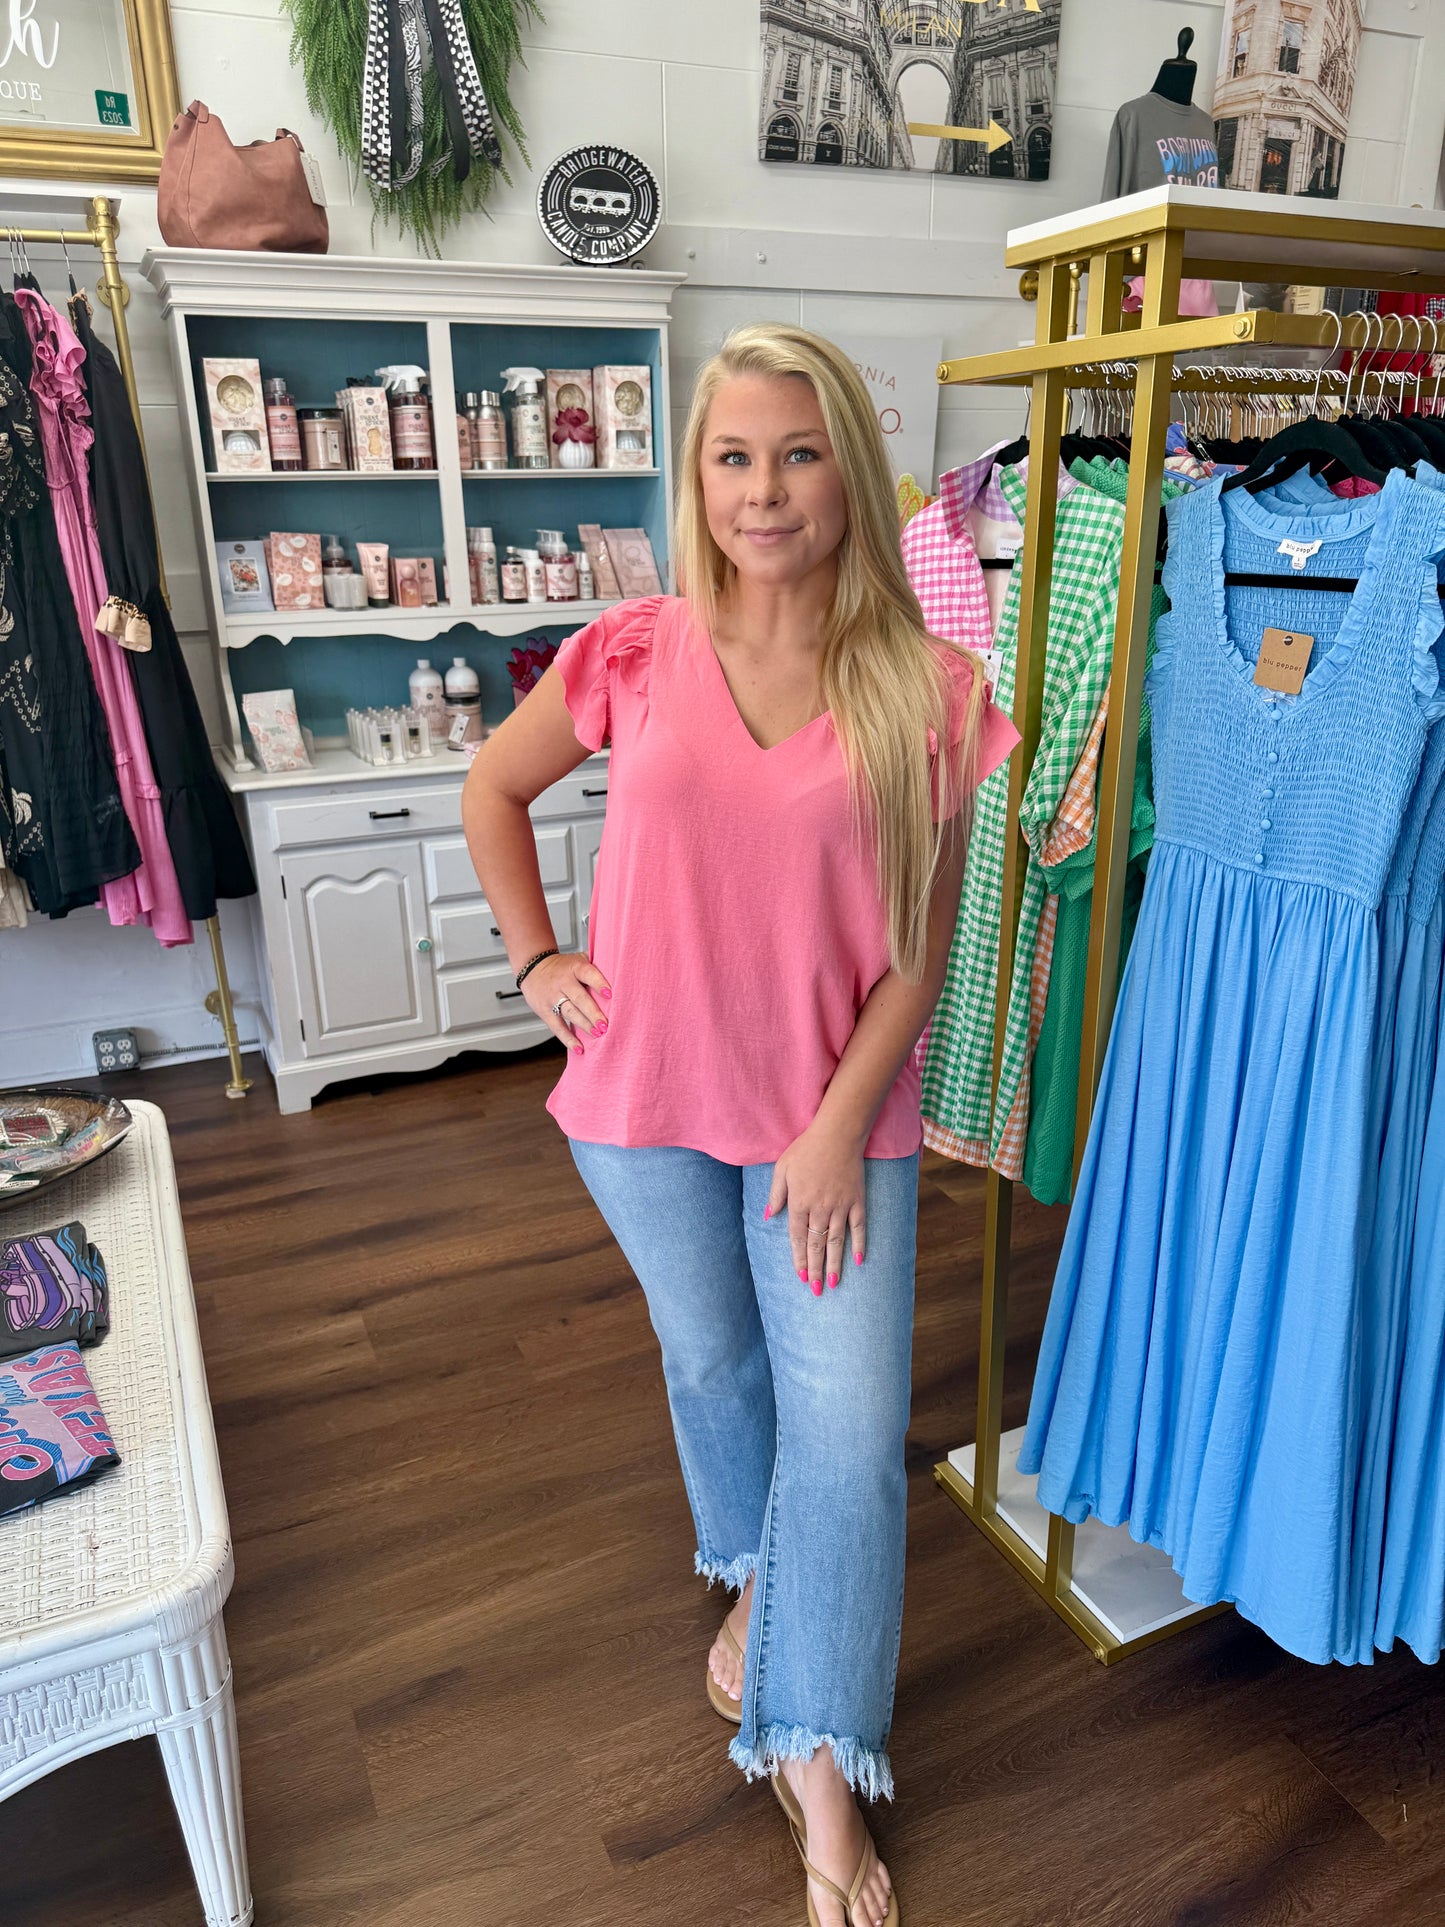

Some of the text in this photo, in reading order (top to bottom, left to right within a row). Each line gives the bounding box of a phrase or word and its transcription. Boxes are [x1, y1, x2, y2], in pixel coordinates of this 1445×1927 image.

[879, 7, 963, 38] MILAN
[1270, 102, 1297, 112] GUCCI
[559, 150, 648, 187] BRIDGEWATER
[546, 211, 649, 256] CANDLE COMPANY
[1262, 657, 1303, 673] blu pepper
[11, 1347, 116, 1458] TEXAS
